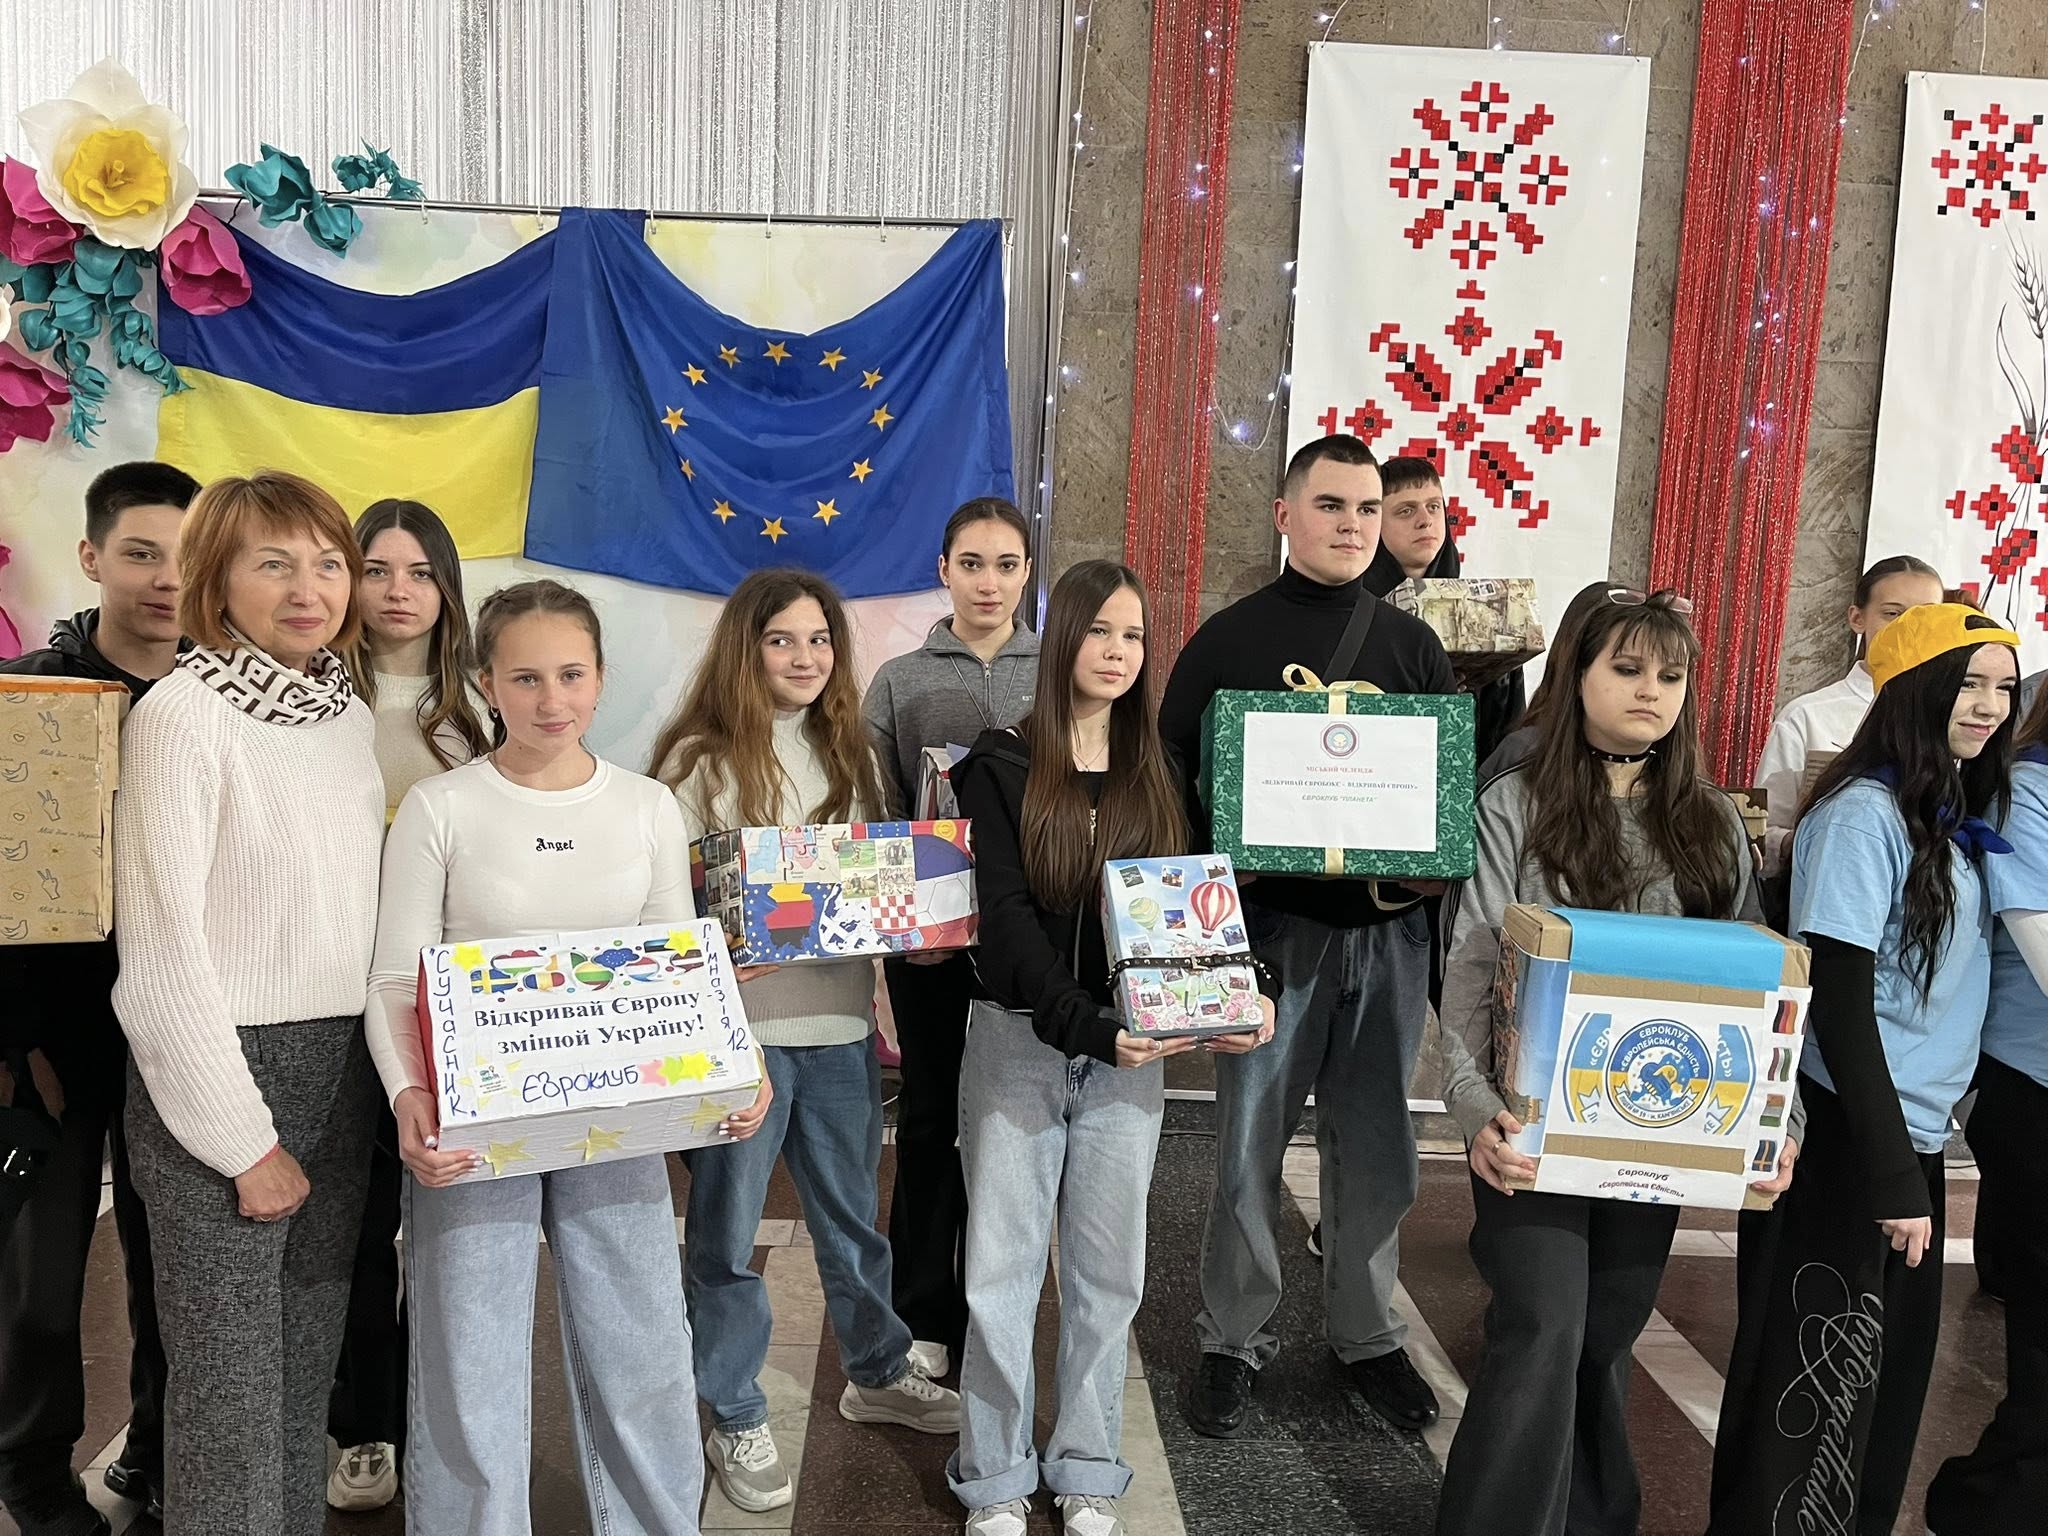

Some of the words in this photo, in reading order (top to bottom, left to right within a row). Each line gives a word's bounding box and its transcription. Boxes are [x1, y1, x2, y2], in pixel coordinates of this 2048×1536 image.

[536, 837, 574, 852] Angel
[474, 1001, 604, 1027] Відкривай
[611, 992, 700, 1015] Європу
[497, 1029, 591, 1055] змінюй
[597, 1013, 705, 1045] Україну!
[727, 1027, 749, 1051] 12
[1639, 1025, 1691, 1043] ЄВРОКЛУБ
[1618, 1168, 1670, 1181] Євроклуб
